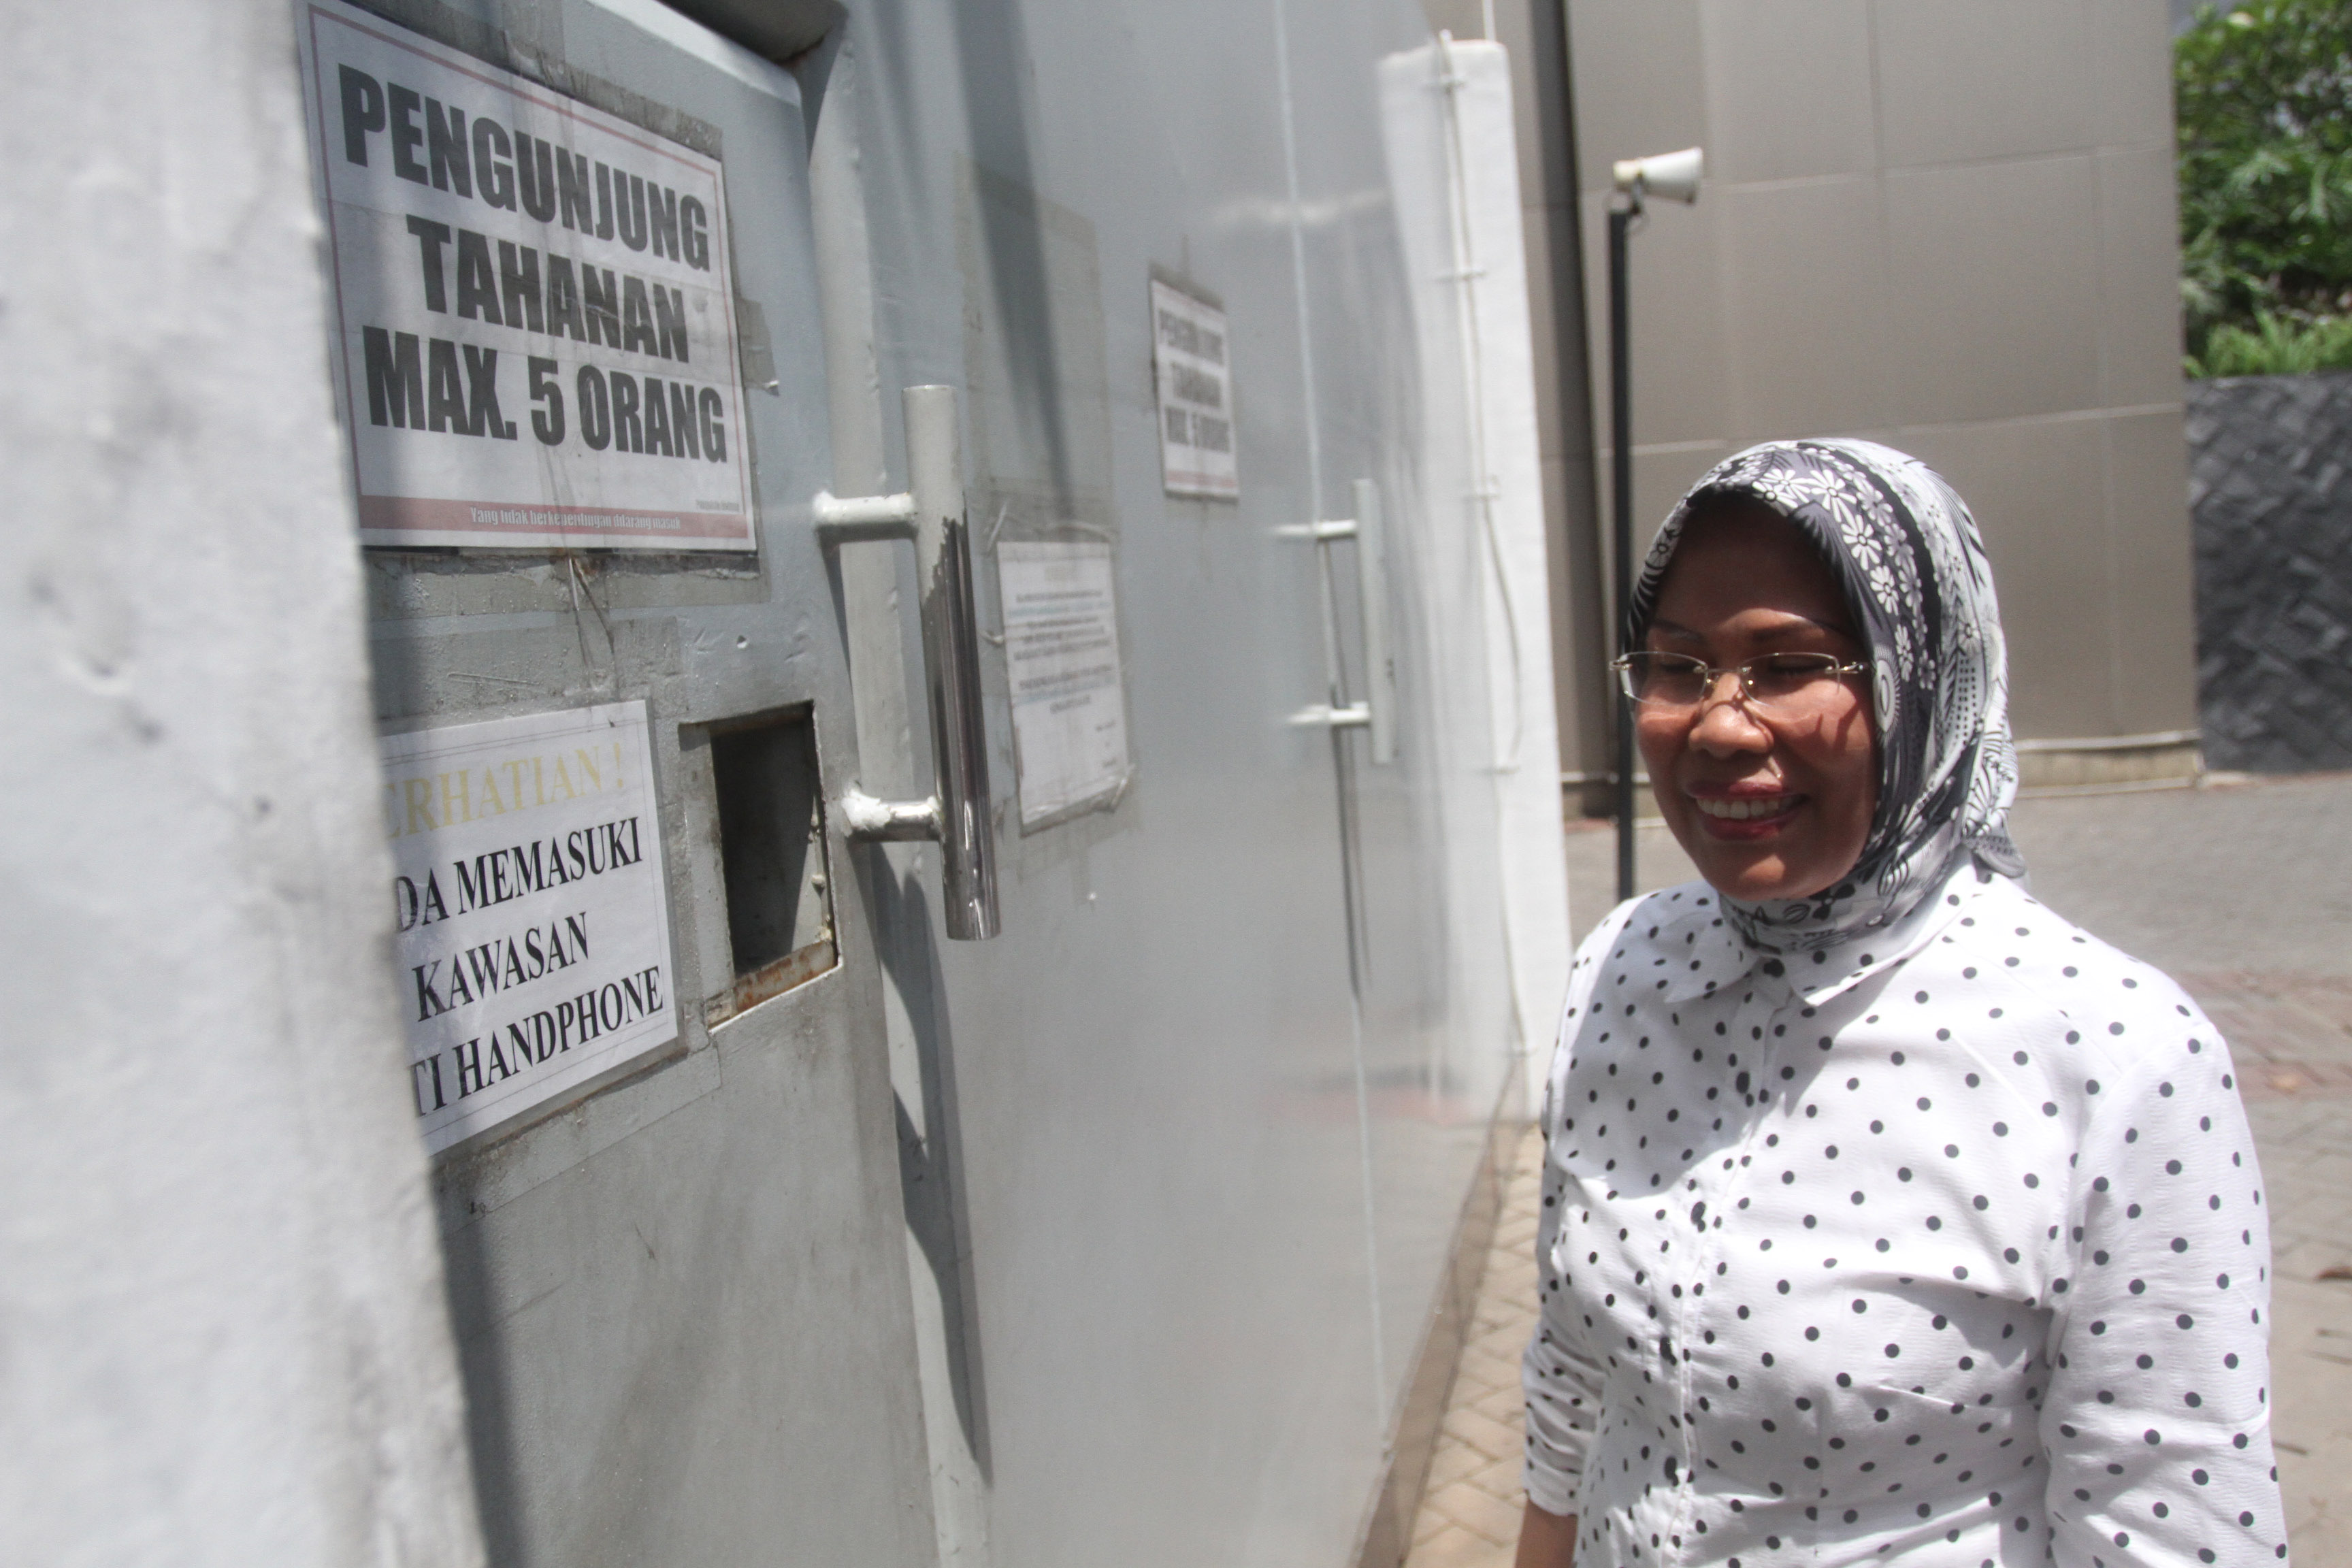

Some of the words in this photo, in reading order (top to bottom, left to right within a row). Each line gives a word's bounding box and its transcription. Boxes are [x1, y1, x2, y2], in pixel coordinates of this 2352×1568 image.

[338, 63, 710, 272] PENGUNJUNG
[406, 214, 689, 363] TAHANAN
[362, 325, 518, 441] MAX.
[527, 355, 566, 446] 5
[577, 364, 727, 463] ORANG
[470, 506, 498, 525] Yang
[500, 509, 528, 525] tidak
[530, 510, 611, 528] berkepentingan
[652, 516, 681, 529] masuk
[453, 817, 643, 915] MEMASUKI
[412, 912, 589, 1022] KAWASAN
[453, 966, 664, 1100] HANDPHONE
